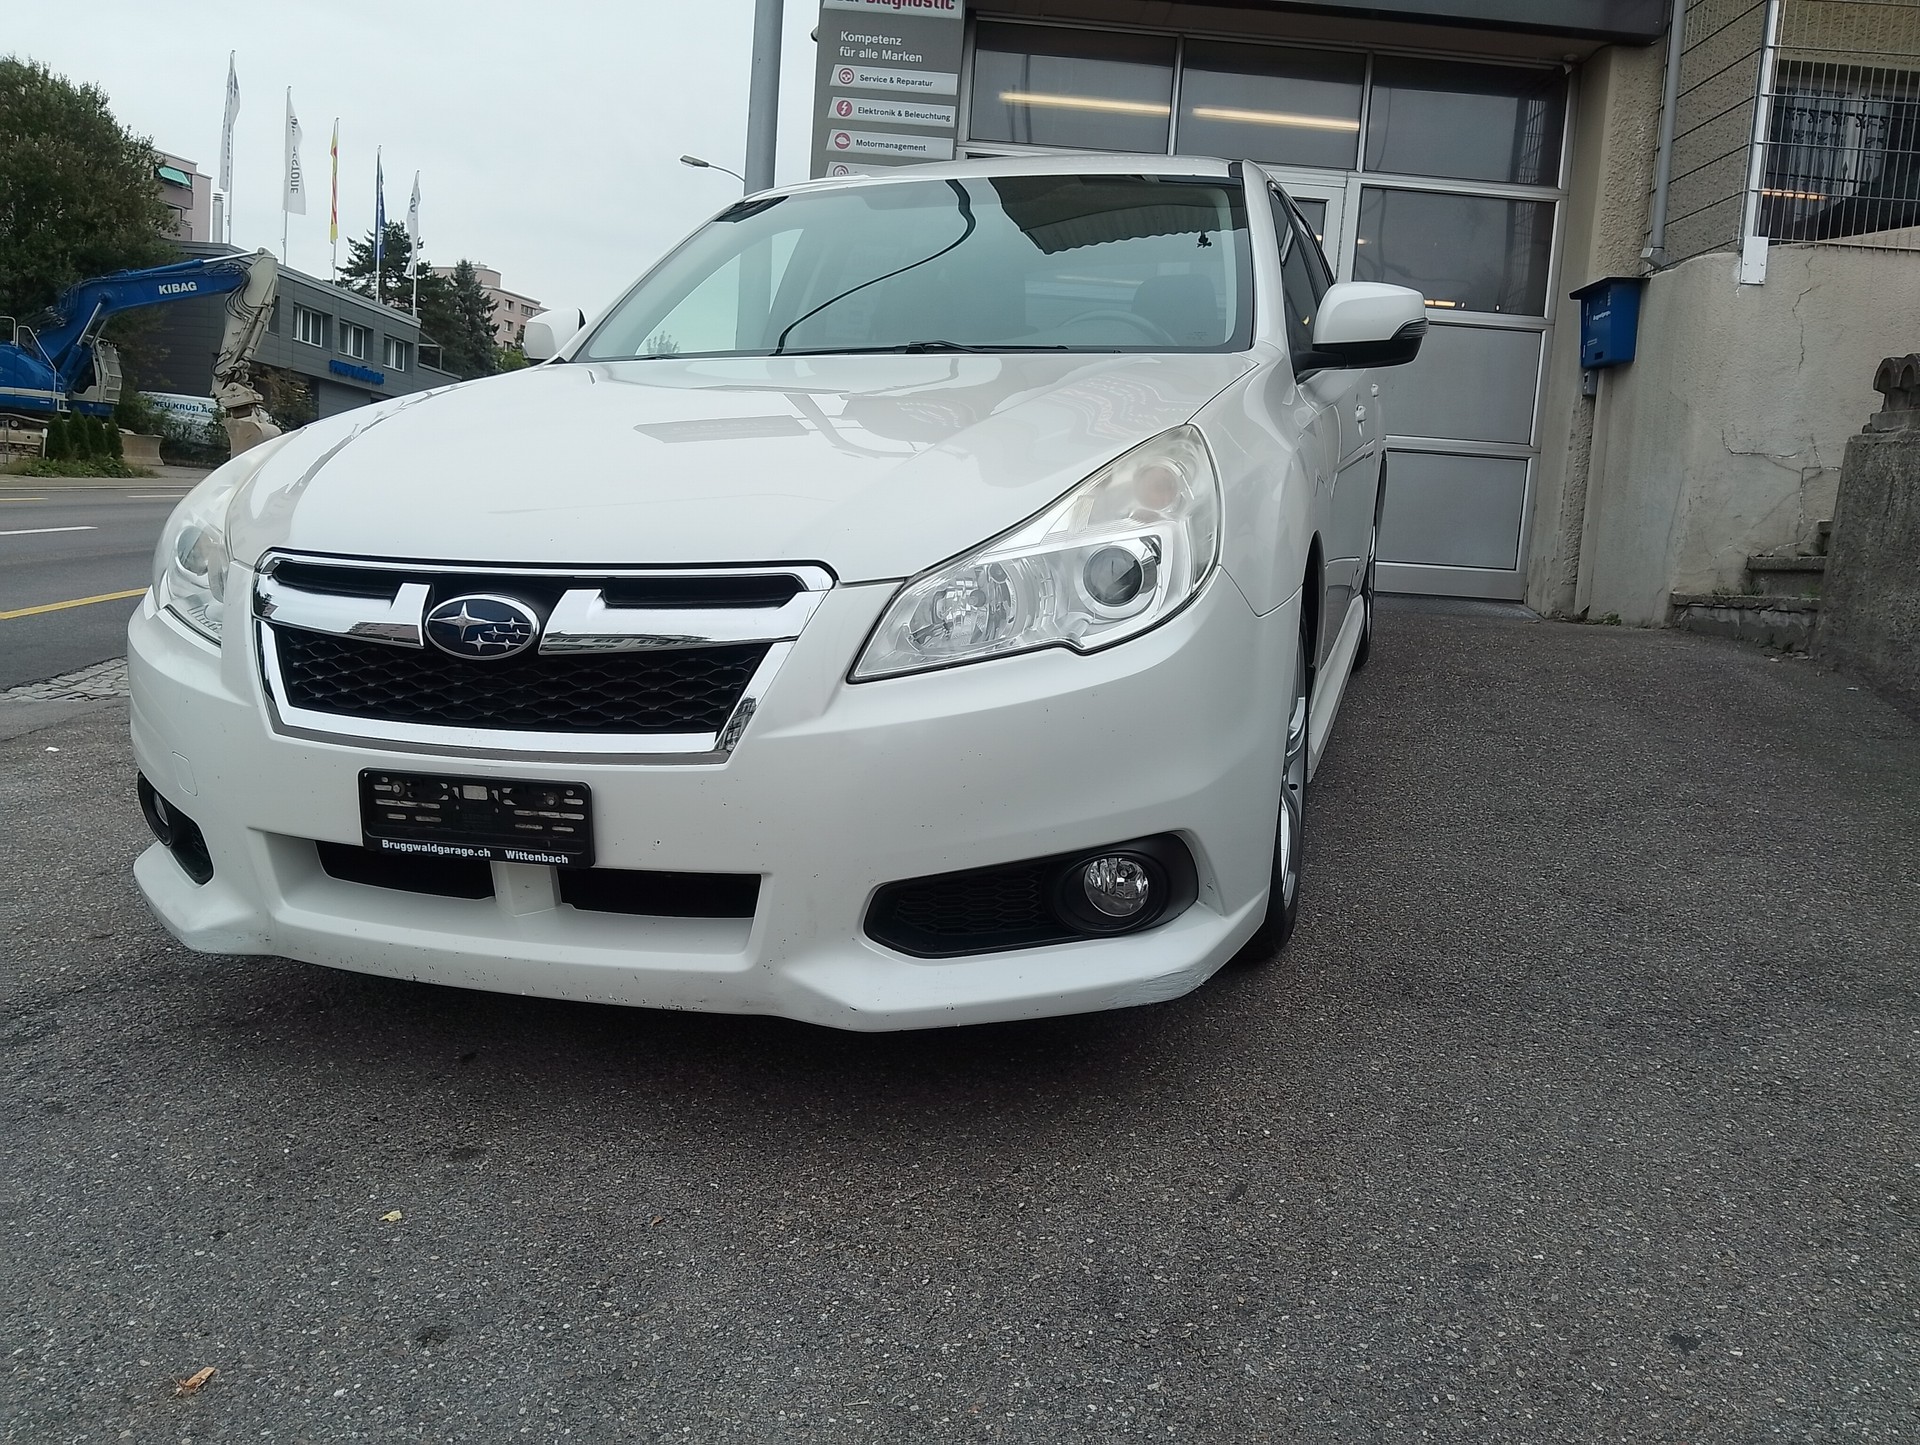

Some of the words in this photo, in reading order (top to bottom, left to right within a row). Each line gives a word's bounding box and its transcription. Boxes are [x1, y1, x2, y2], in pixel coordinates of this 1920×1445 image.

[840, 31, 902, 46] Kompetenz
[839, 46, 856, 57] für
[859, 48, 878, 59] alle
[882, 51, 922, 63] Marken
[860, 74, 887, 84] Service
[896, 77, 933, 88] Reparatur
[858, 106, 895, 117] Elektronik
[904, 110, 951, 122] Beleuchtung
[856, 139, 926, 152] Motormanagement
[158, 281, 198, 295] KIBAG
[381, 839, 491, 858] Bruggwaldgarage.ch
[505, 850, 569, 864] Wittenbach
